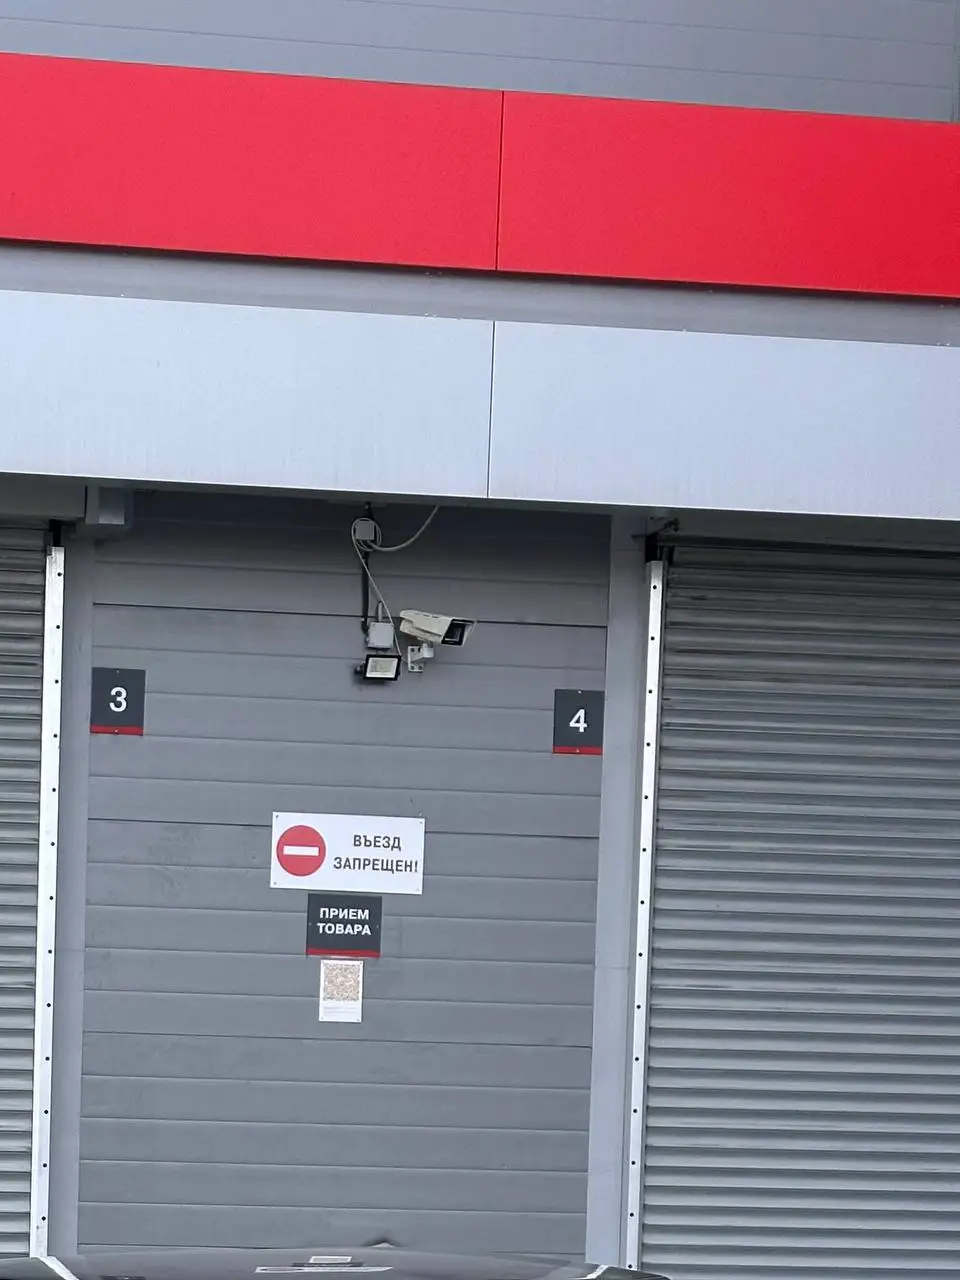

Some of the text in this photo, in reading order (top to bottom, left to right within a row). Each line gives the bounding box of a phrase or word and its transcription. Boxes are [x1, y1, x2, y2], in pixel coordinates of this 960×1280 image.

[109, 686, 127, 712] 3
[569, 708, 588, 733] 4
[353, 834, 402, 851] ВЪЕЗД
[333, 856, 418, 874] ЗАПРЕЩЕН!
[319, 907, 370, 920] ПРИЕМ
[316, 922, 372, 936] ТОВАРА
